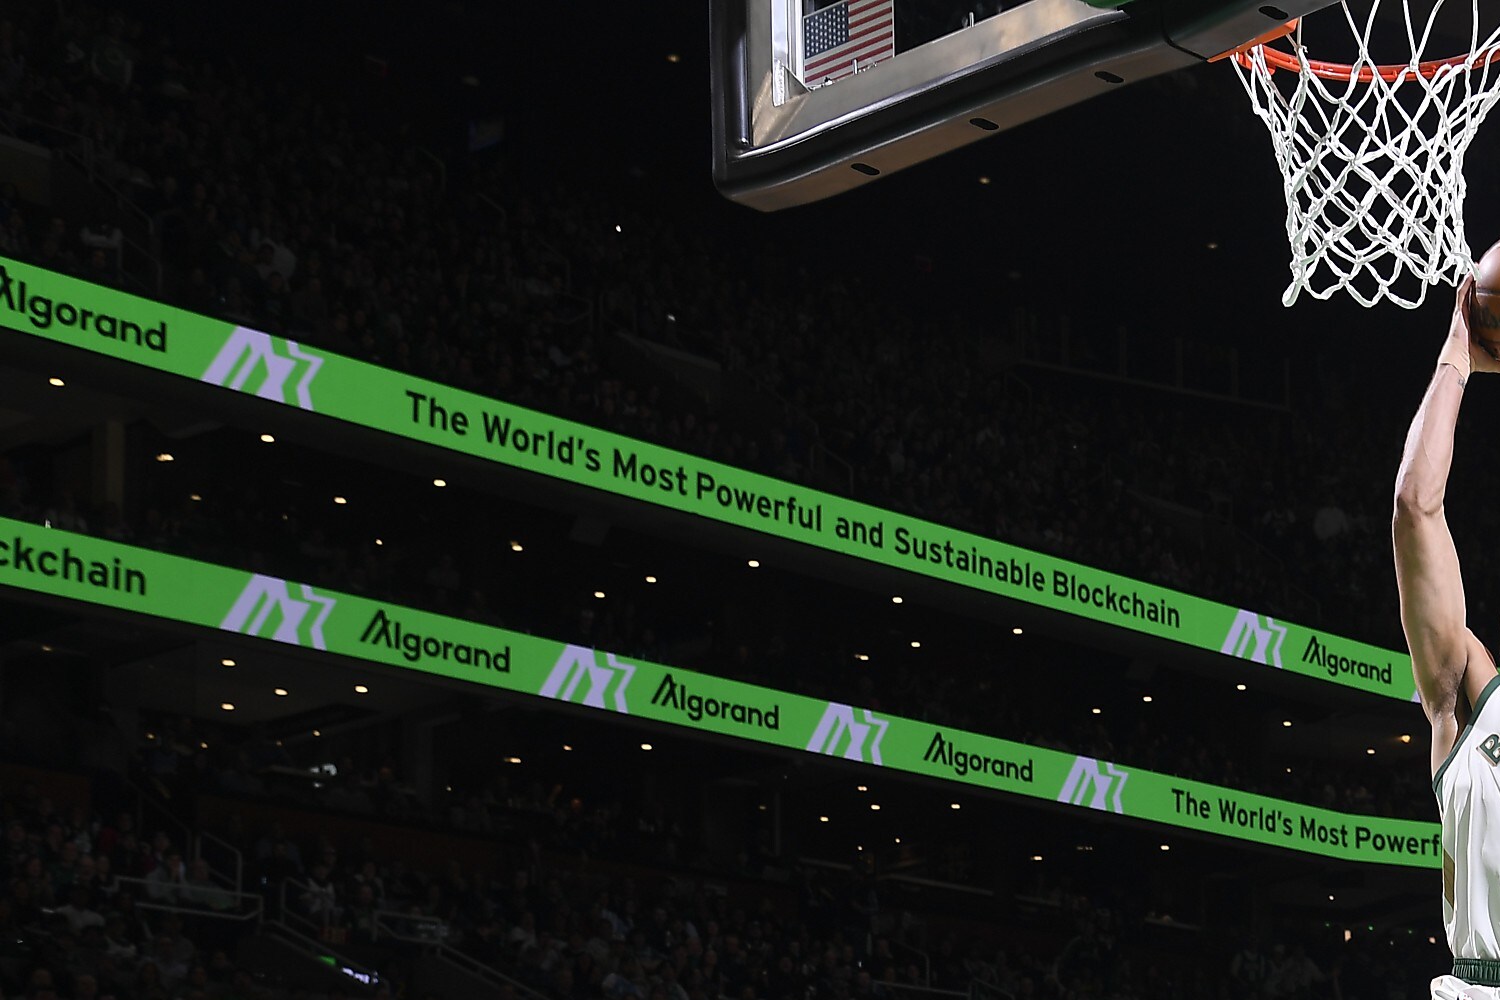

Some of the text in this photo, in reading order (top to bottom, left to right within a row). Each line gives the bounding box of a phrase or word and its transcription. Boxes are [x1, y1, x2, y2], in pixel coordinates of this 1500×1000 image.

[405, 389, 1180, 628] The World's Most Powerful and Sustainable Blockchain
[358, 608, 511, 674] Algorand
[1301, 635, 1393, 685] Algorand
[649, 673, 780, 731] Algorand
[922, 732, 1033, 783] Algorand
[1171, 788, 1441, 858] The World's Most Powerf
